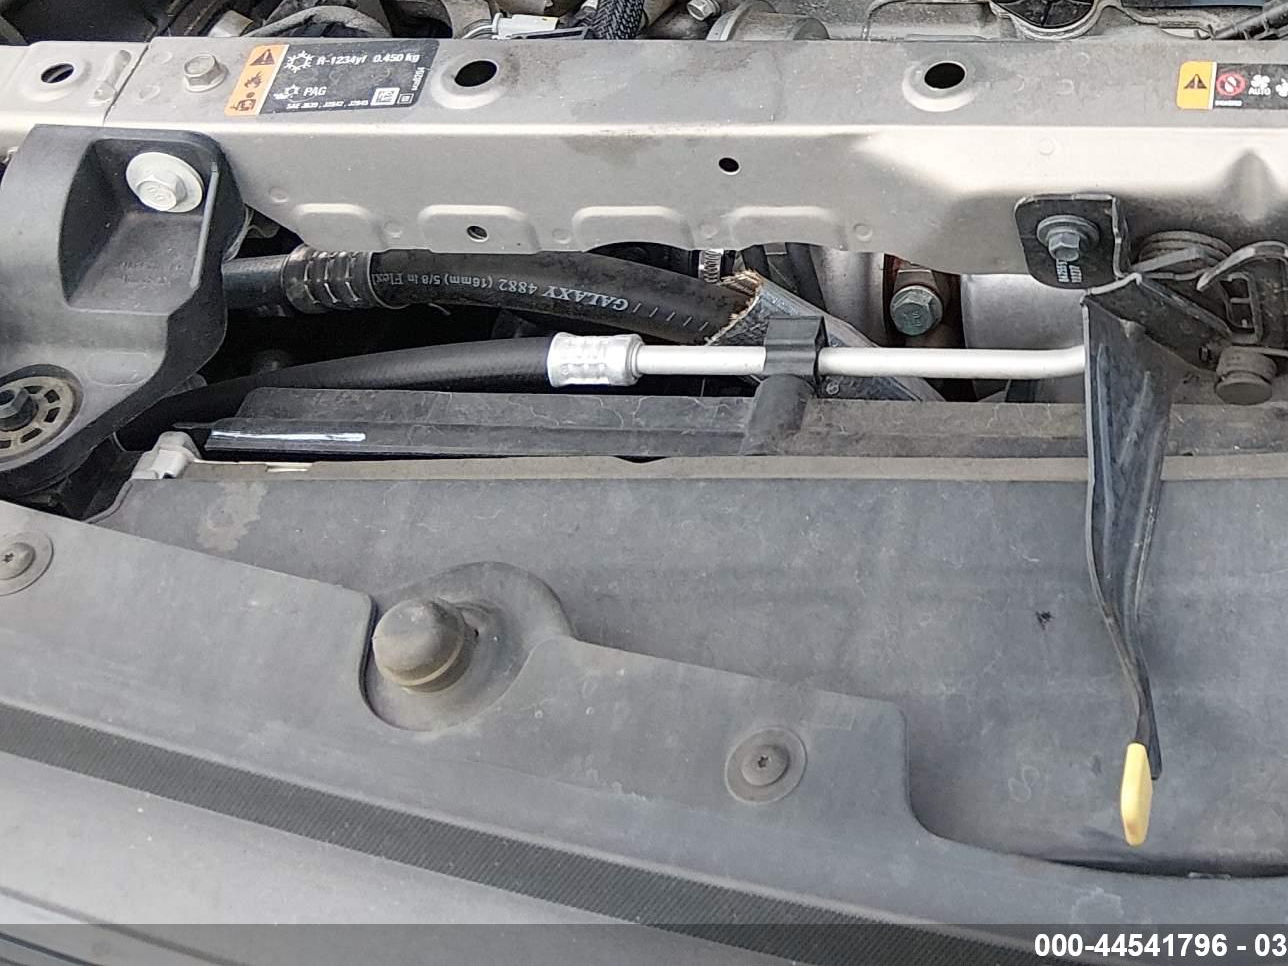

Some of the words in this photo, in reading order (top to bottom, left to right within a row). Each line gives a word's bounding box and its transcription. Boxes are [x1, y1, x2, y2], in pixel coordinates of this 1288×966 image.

[372, 52, 405, 63] 0.450
[405, 52, 420, 63] kg
[303, 85, 328, 97] PAG
[1248, 87, 1271, 95] AUTO
[421, 273, 441, 285] 5/8
[444, 273, 494, 288] (16mm)
[498, 278, 538, 294] 4882
[542, 285, 630, 312] GALAXY
